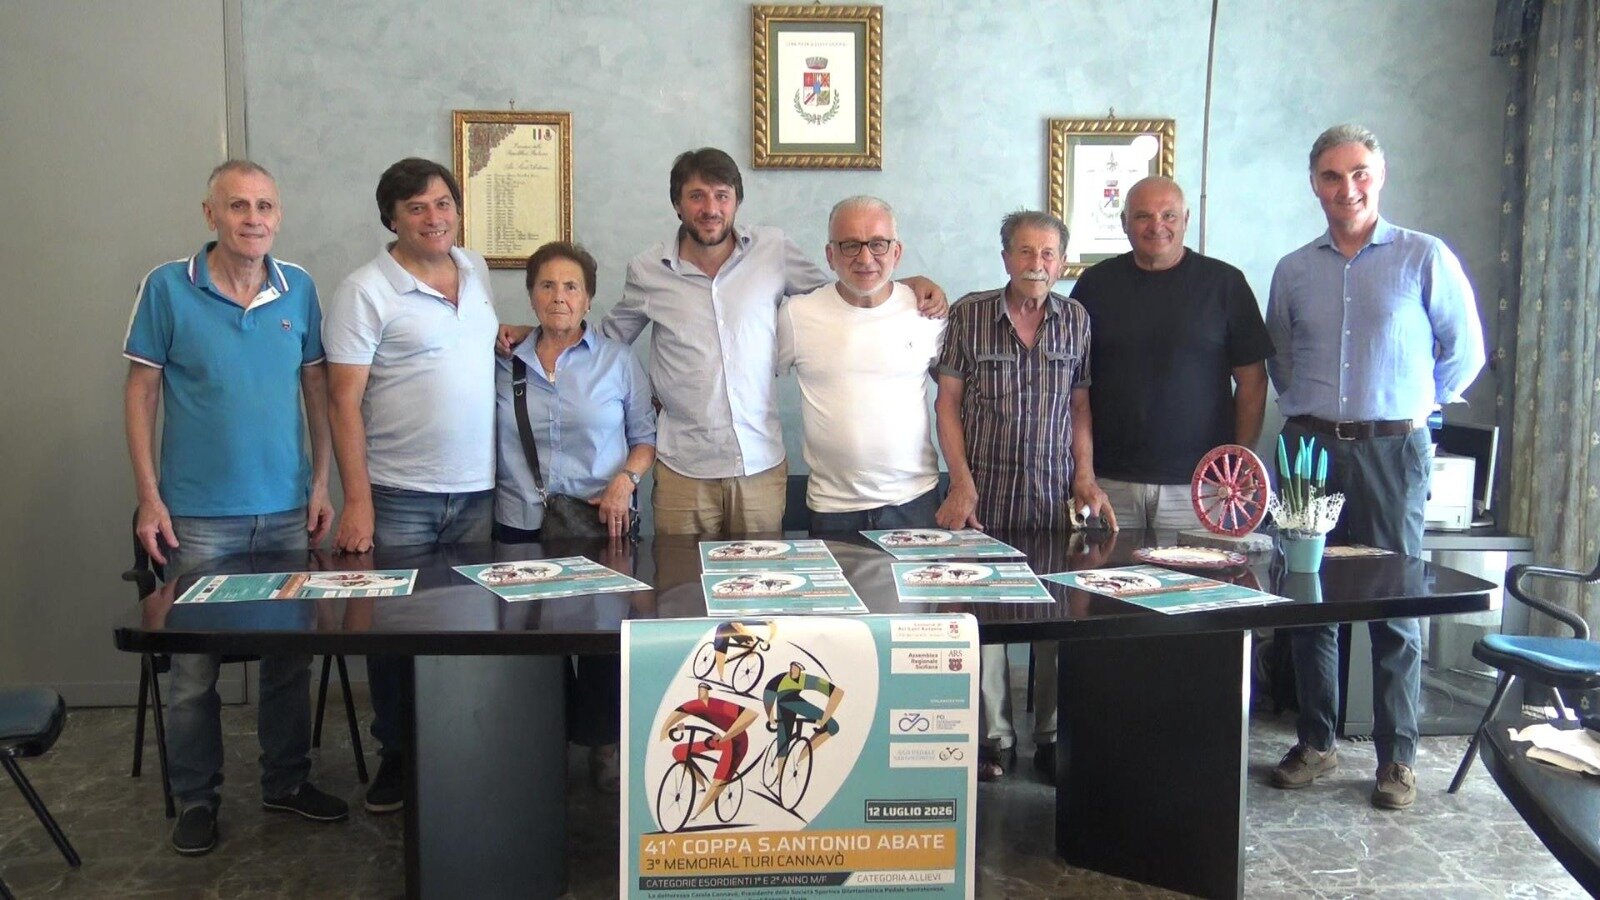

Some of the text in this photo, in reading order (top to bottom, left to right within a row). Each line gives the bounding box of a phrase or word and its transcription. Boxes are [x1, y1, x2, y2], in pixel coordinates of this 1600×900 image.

[868, 806, 953, 817] 12 LUGLIO 2026
[644, 834, 945, 855] 41^ COPPA S.ANTONIO ABATE
[664, 855, 739, 870] MEMORIAL
[742, 854, 774, 868] TURI
[777, 851, 844, 867] CANNAVÒ
[646, 880, 697, 888] CATEGORIE
[698, 877, 752, 887] ESORDIENTI
[781, 875, 809, 884] ANNO
[810, 874, 827, 883] M/F
[857, 872, 941, 882] CATEGORIA ALLIEVI
